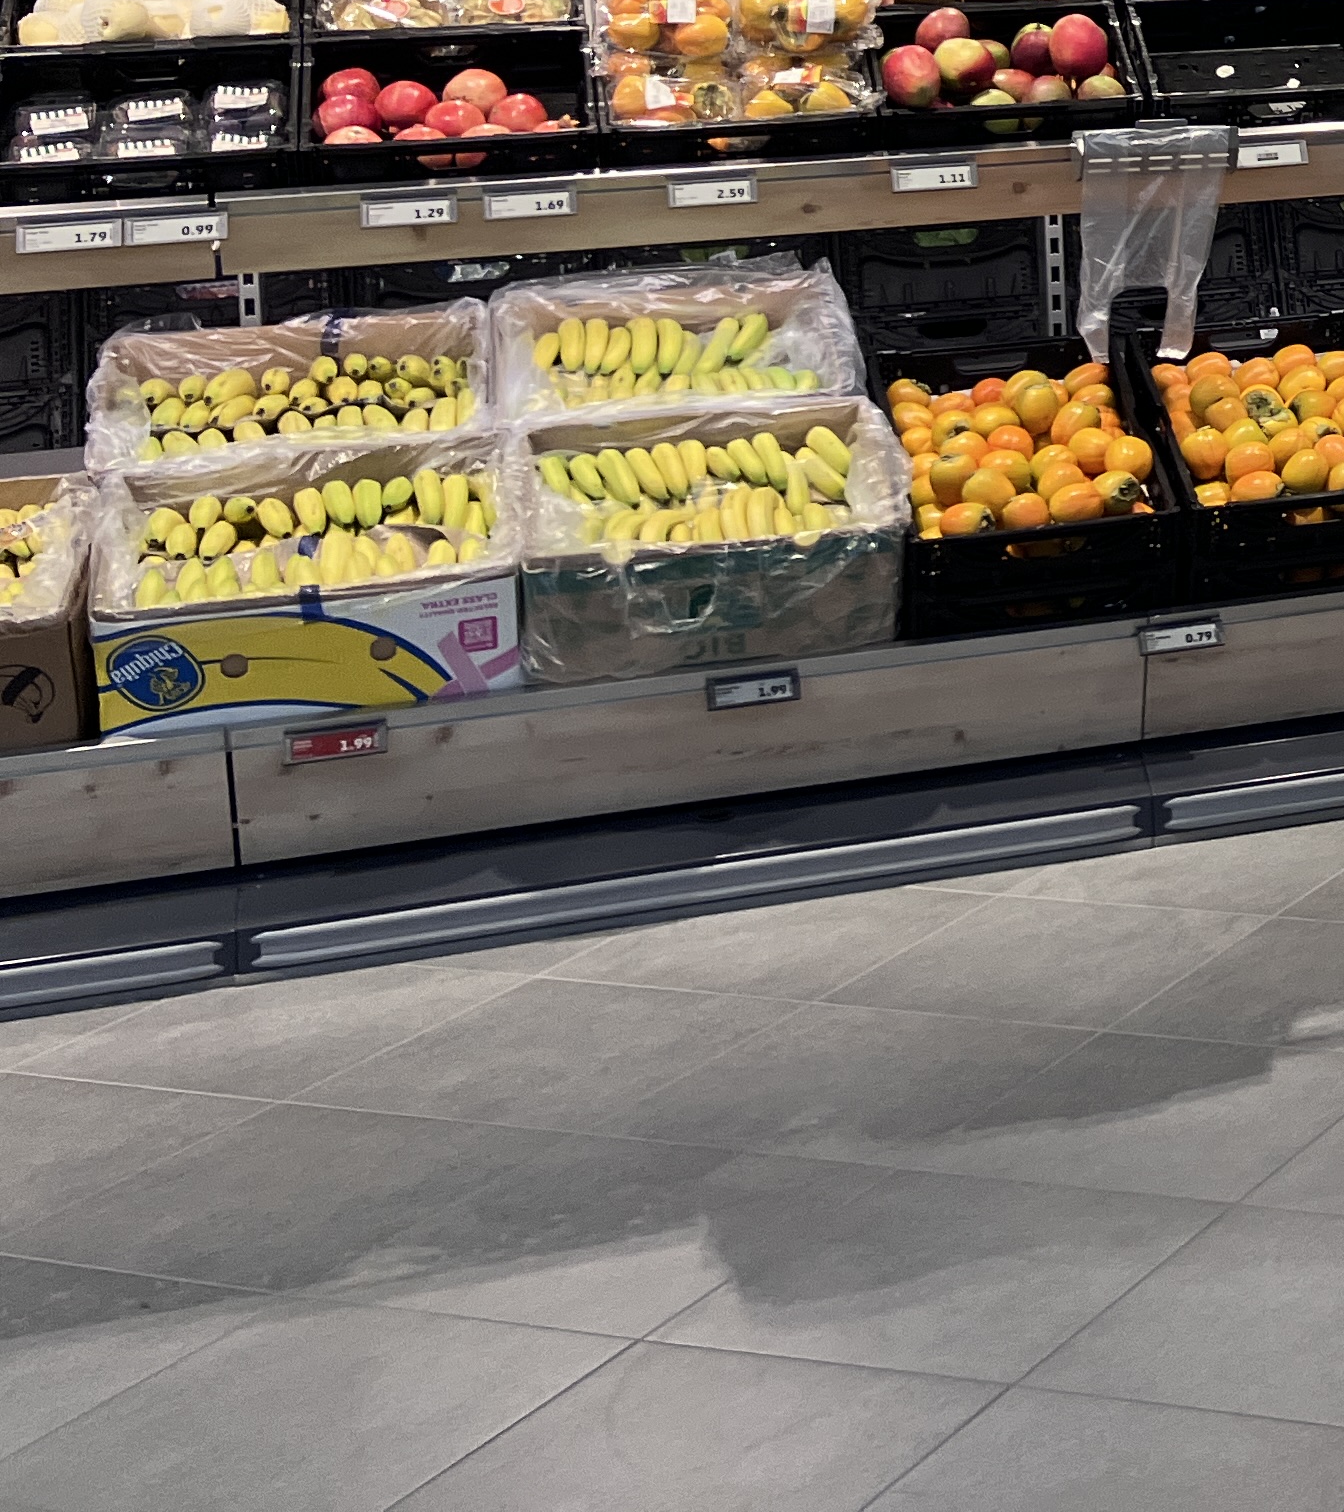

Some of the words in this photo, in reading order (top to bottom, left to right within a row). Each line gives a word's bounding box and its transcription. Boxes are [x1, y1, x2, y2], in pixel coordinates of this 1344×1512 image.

[938, 174, 967, 185] 1.11
[716, 188, 745, 199] 2.59
[535, 199, 564, 211] 1.69
[414, 207, 444, 219] 1.29
[181, 224, 214, 238] 0.99
[74, 232, 108, 245] 1.79
[1185, 631, 1213, 643] 0.79
[110, 641, 184, 685] Chiquita
[758, 684, 788, 698] 1.99
[340, 736, 373, 752] 1.99
